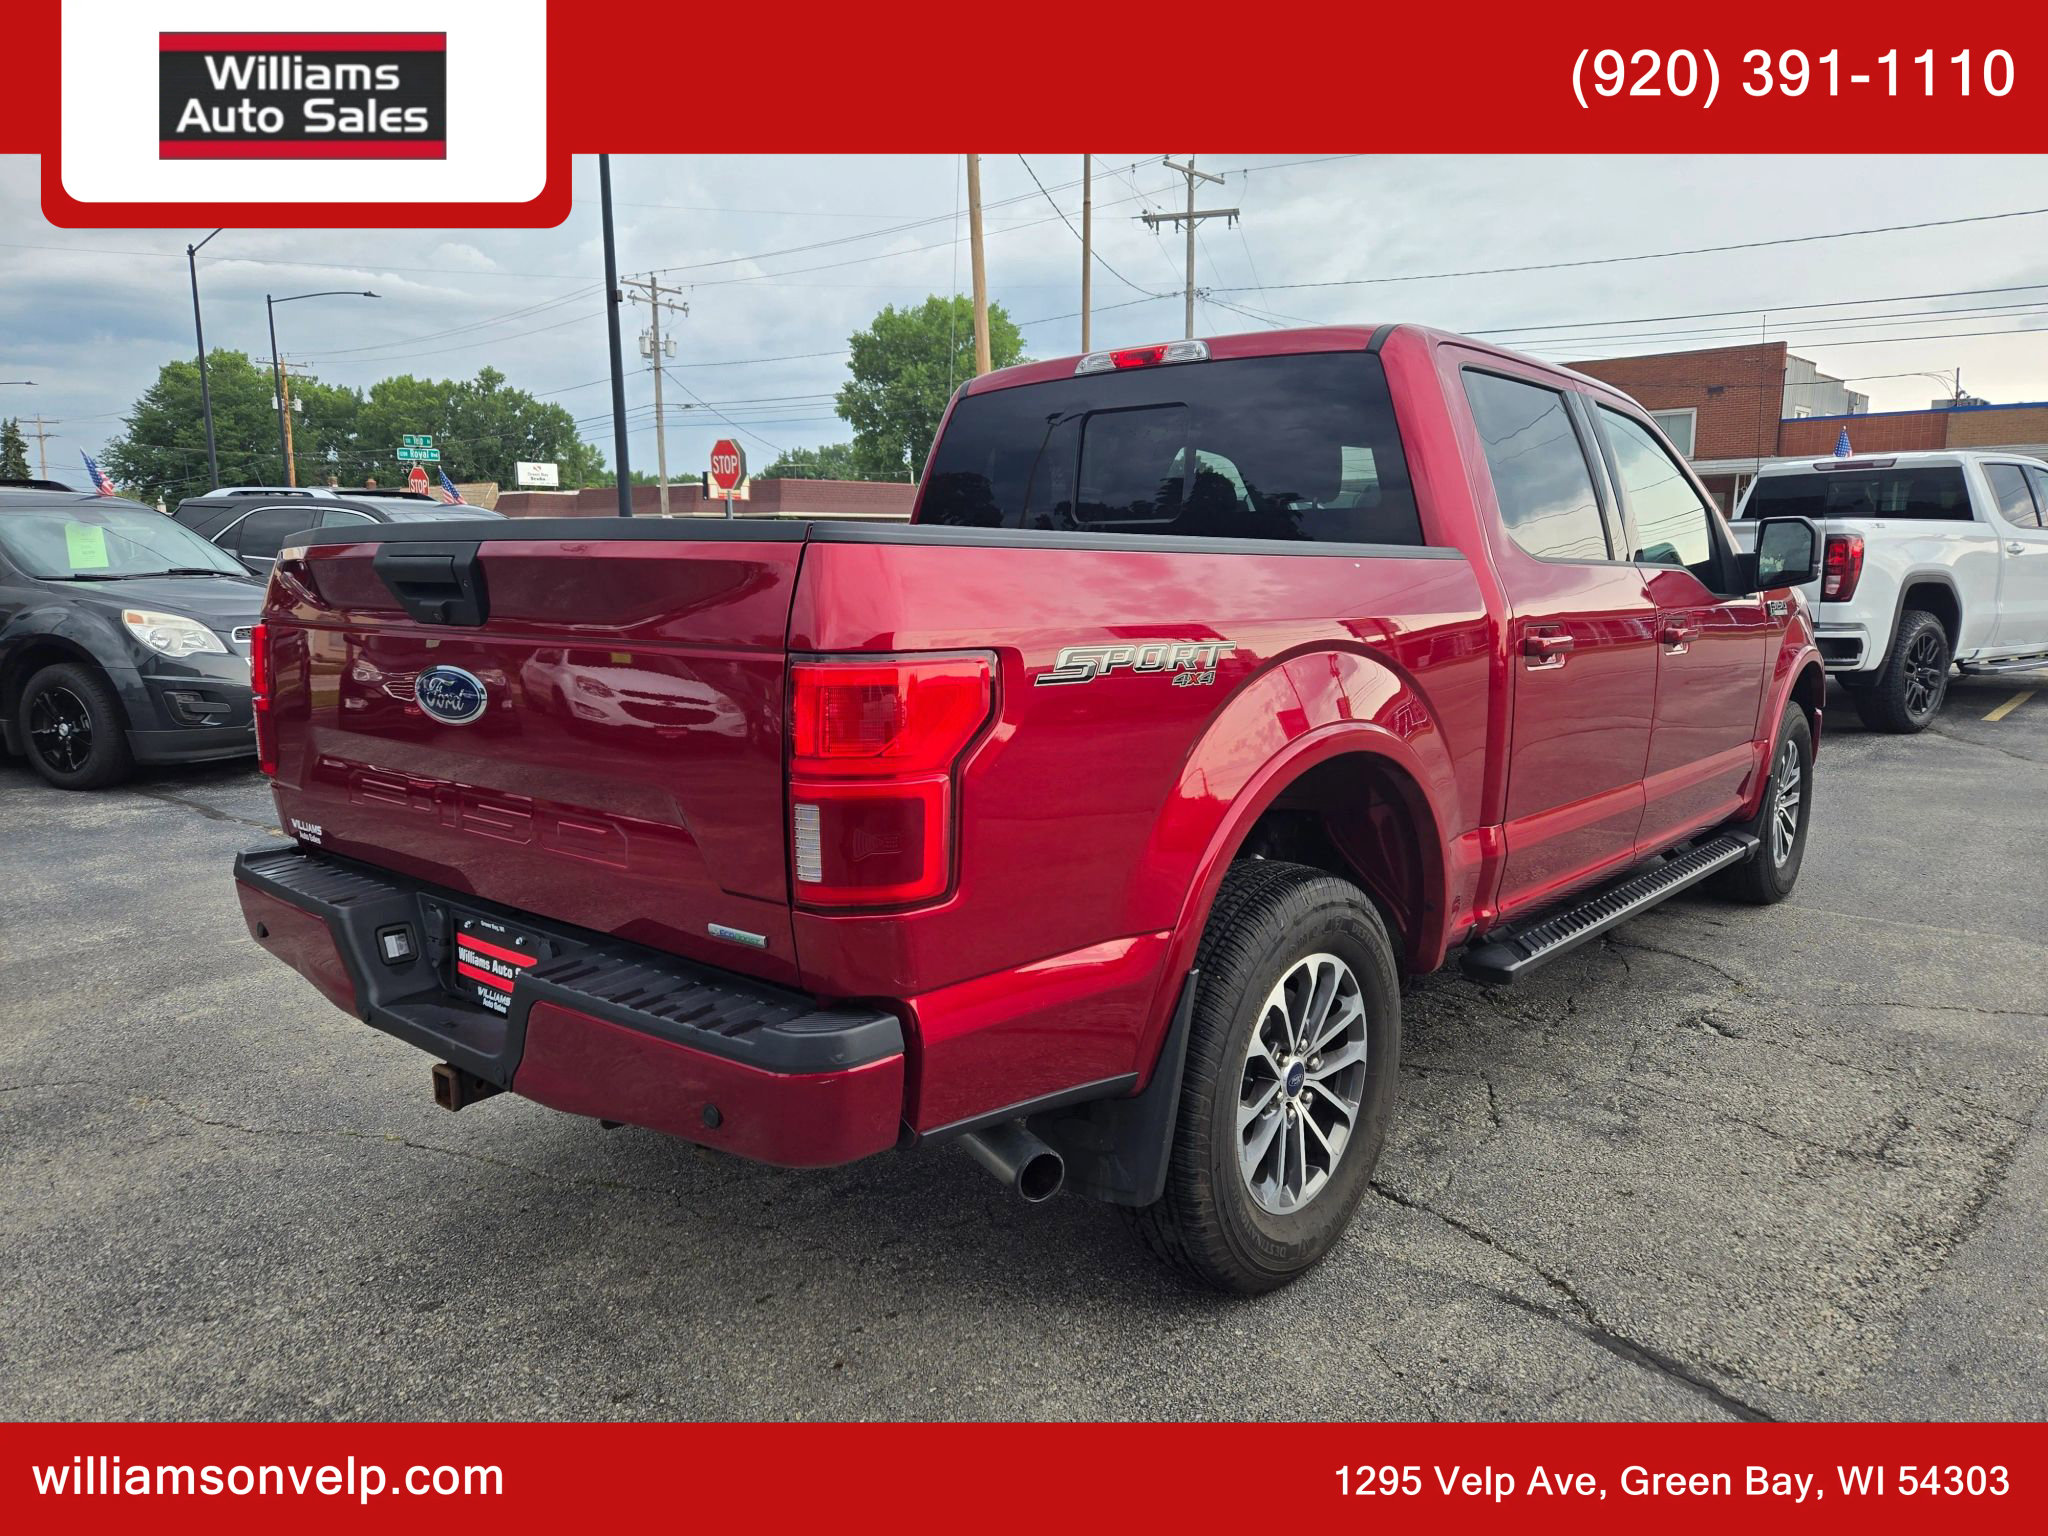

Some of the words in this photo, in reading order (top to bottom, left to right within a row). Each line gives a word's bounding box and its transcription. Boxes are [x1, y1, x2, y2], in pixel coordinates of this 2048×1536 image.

[410, 449, 429, 460] Royal
[712, 455, 738, 474] STOP
[410, 479, 428, 493] STOP
[1034, 640, 1236, 687] SPORT
[425, 676, 465, 712] Ford
[290, 817, 323, 836] WILLIAMS
[458, 946, 491, 971] Williams
[492, 959, 513, 979] Auto
[477, 985, 512, 1007] WILLIAMS
[482, 997, 494, 1009] Auto
